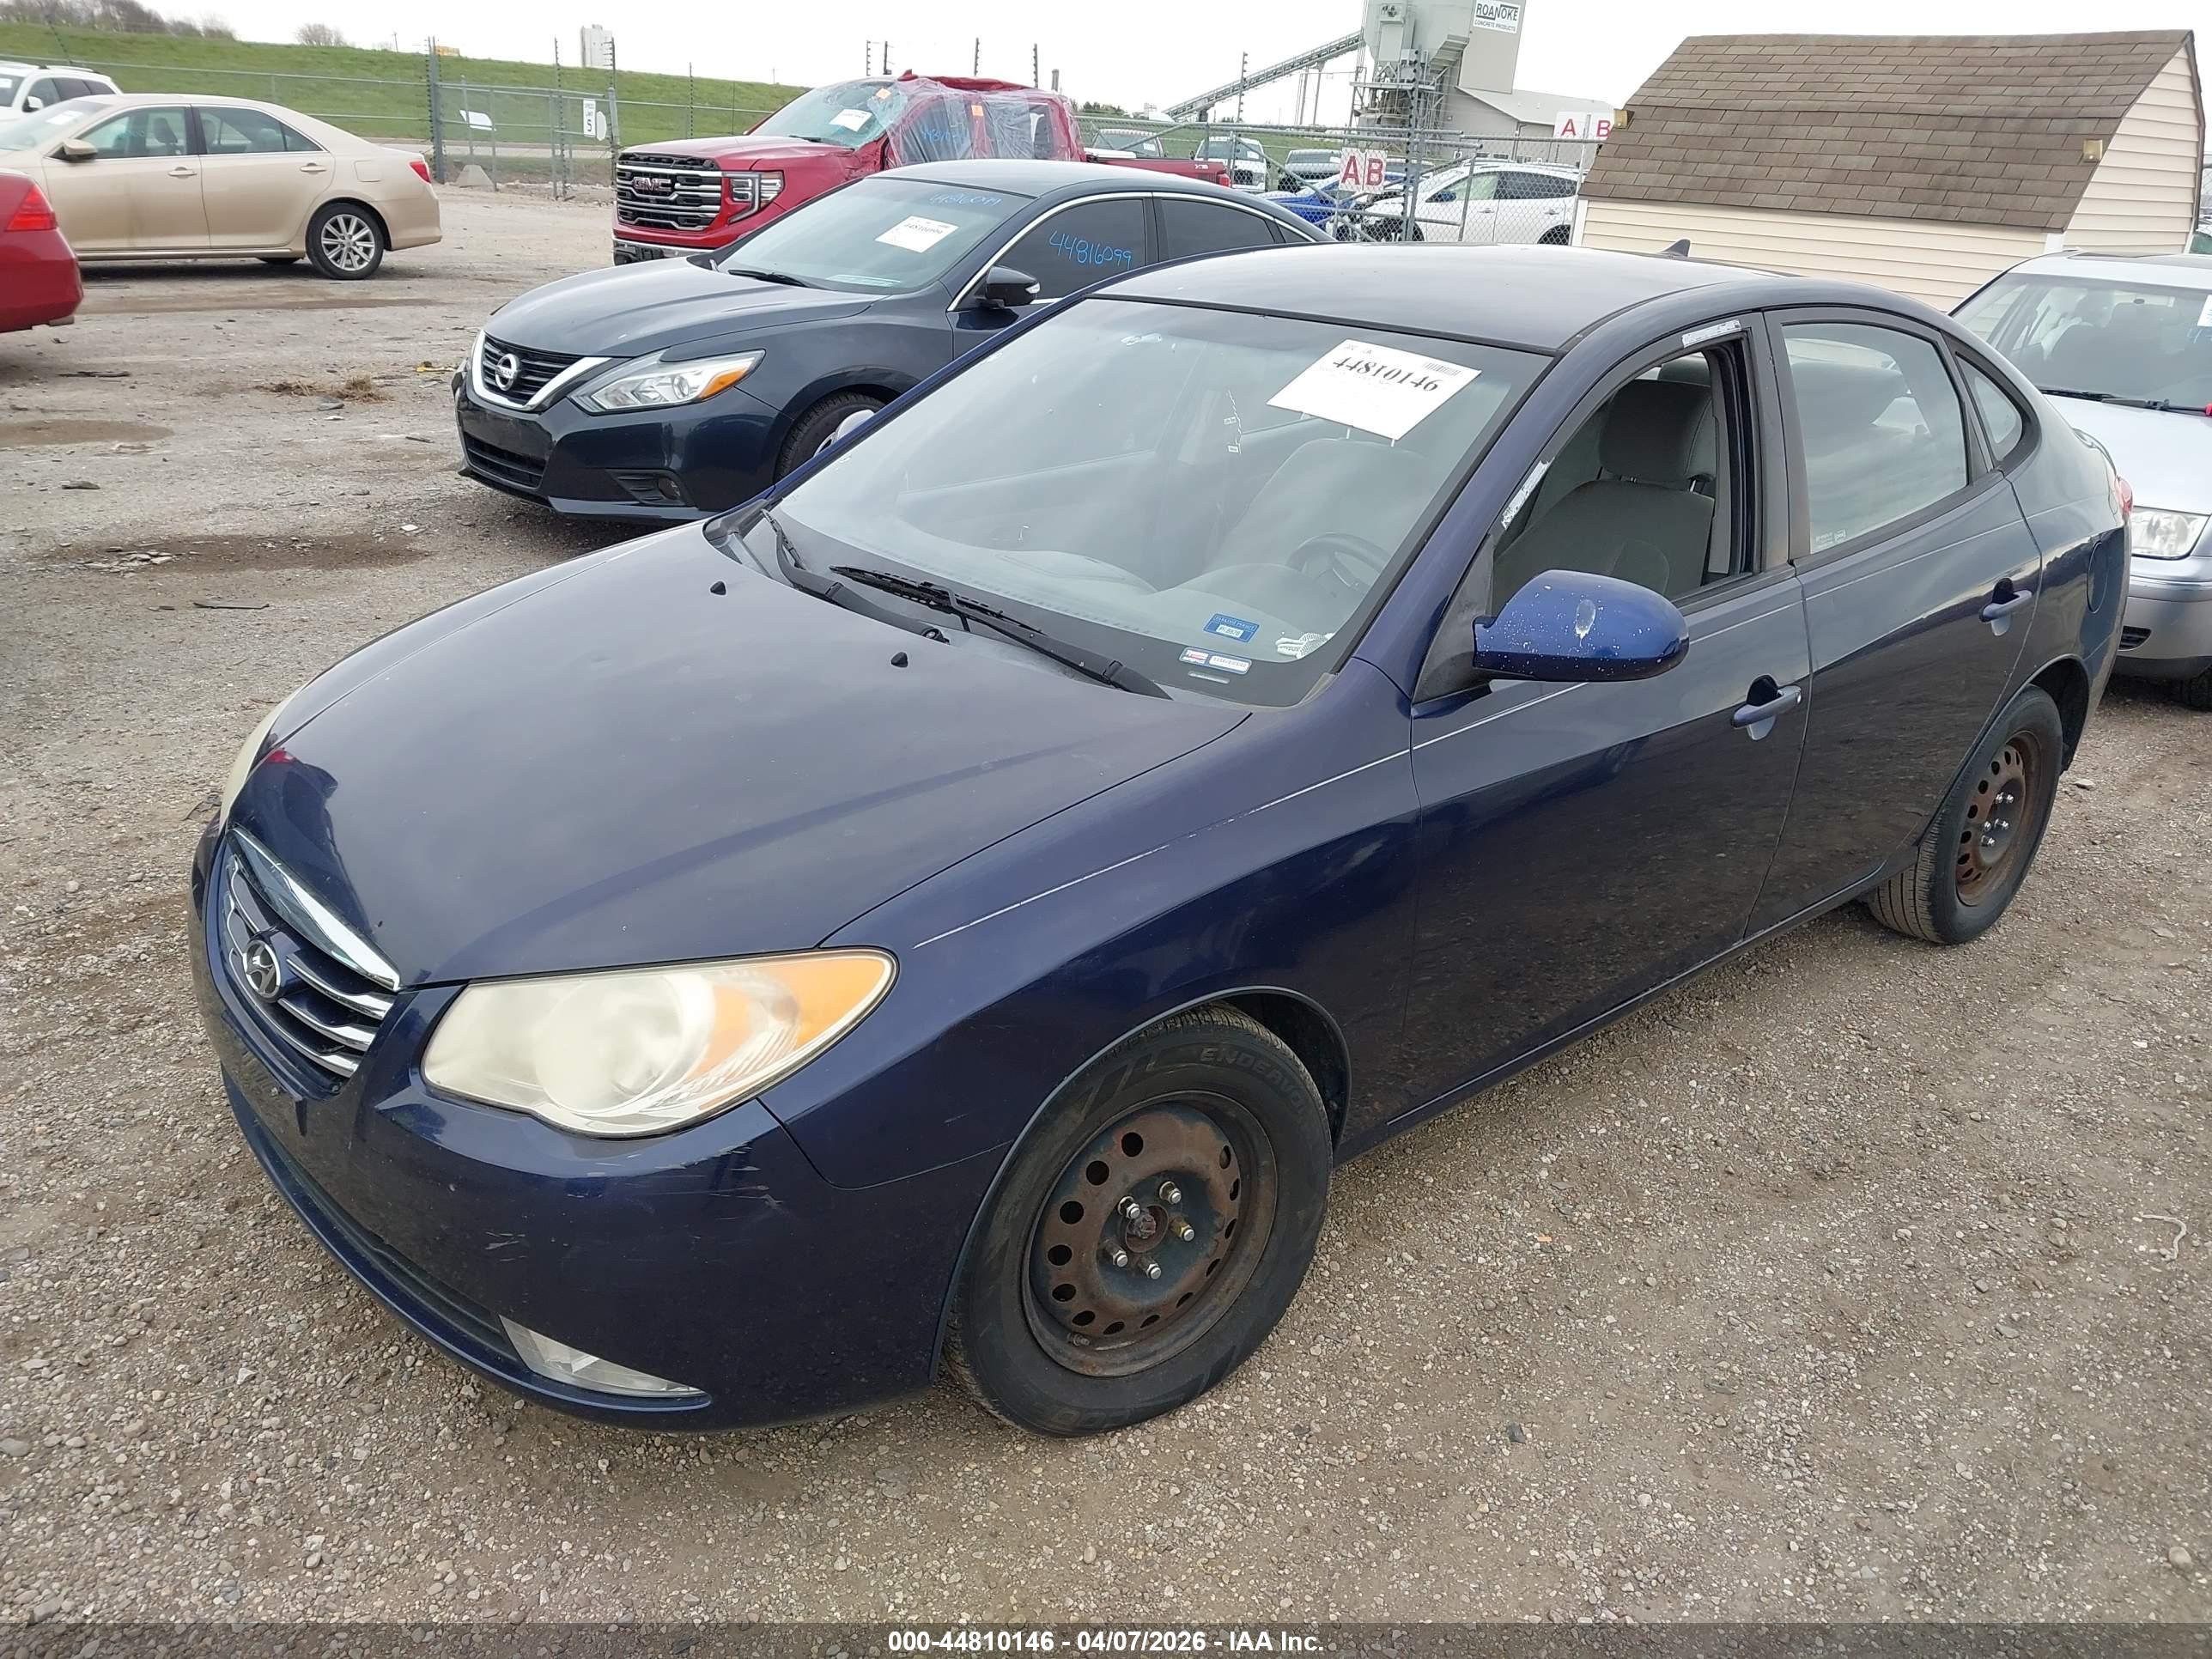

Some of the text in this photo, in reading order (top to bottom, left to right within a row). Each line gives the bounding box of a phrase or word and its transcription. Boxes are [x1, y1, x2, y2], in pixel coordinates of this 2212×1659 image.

[1476, 3, 1519, 21] ROANOKE
[586, 118, 592, 132] 5
[1561, 118, 1611, 137] A B
[632, 176, 672, 191] GMC
[1049, 230, 1133, 271] 44816099
[1333, 356, 1443, 392] 44810146
